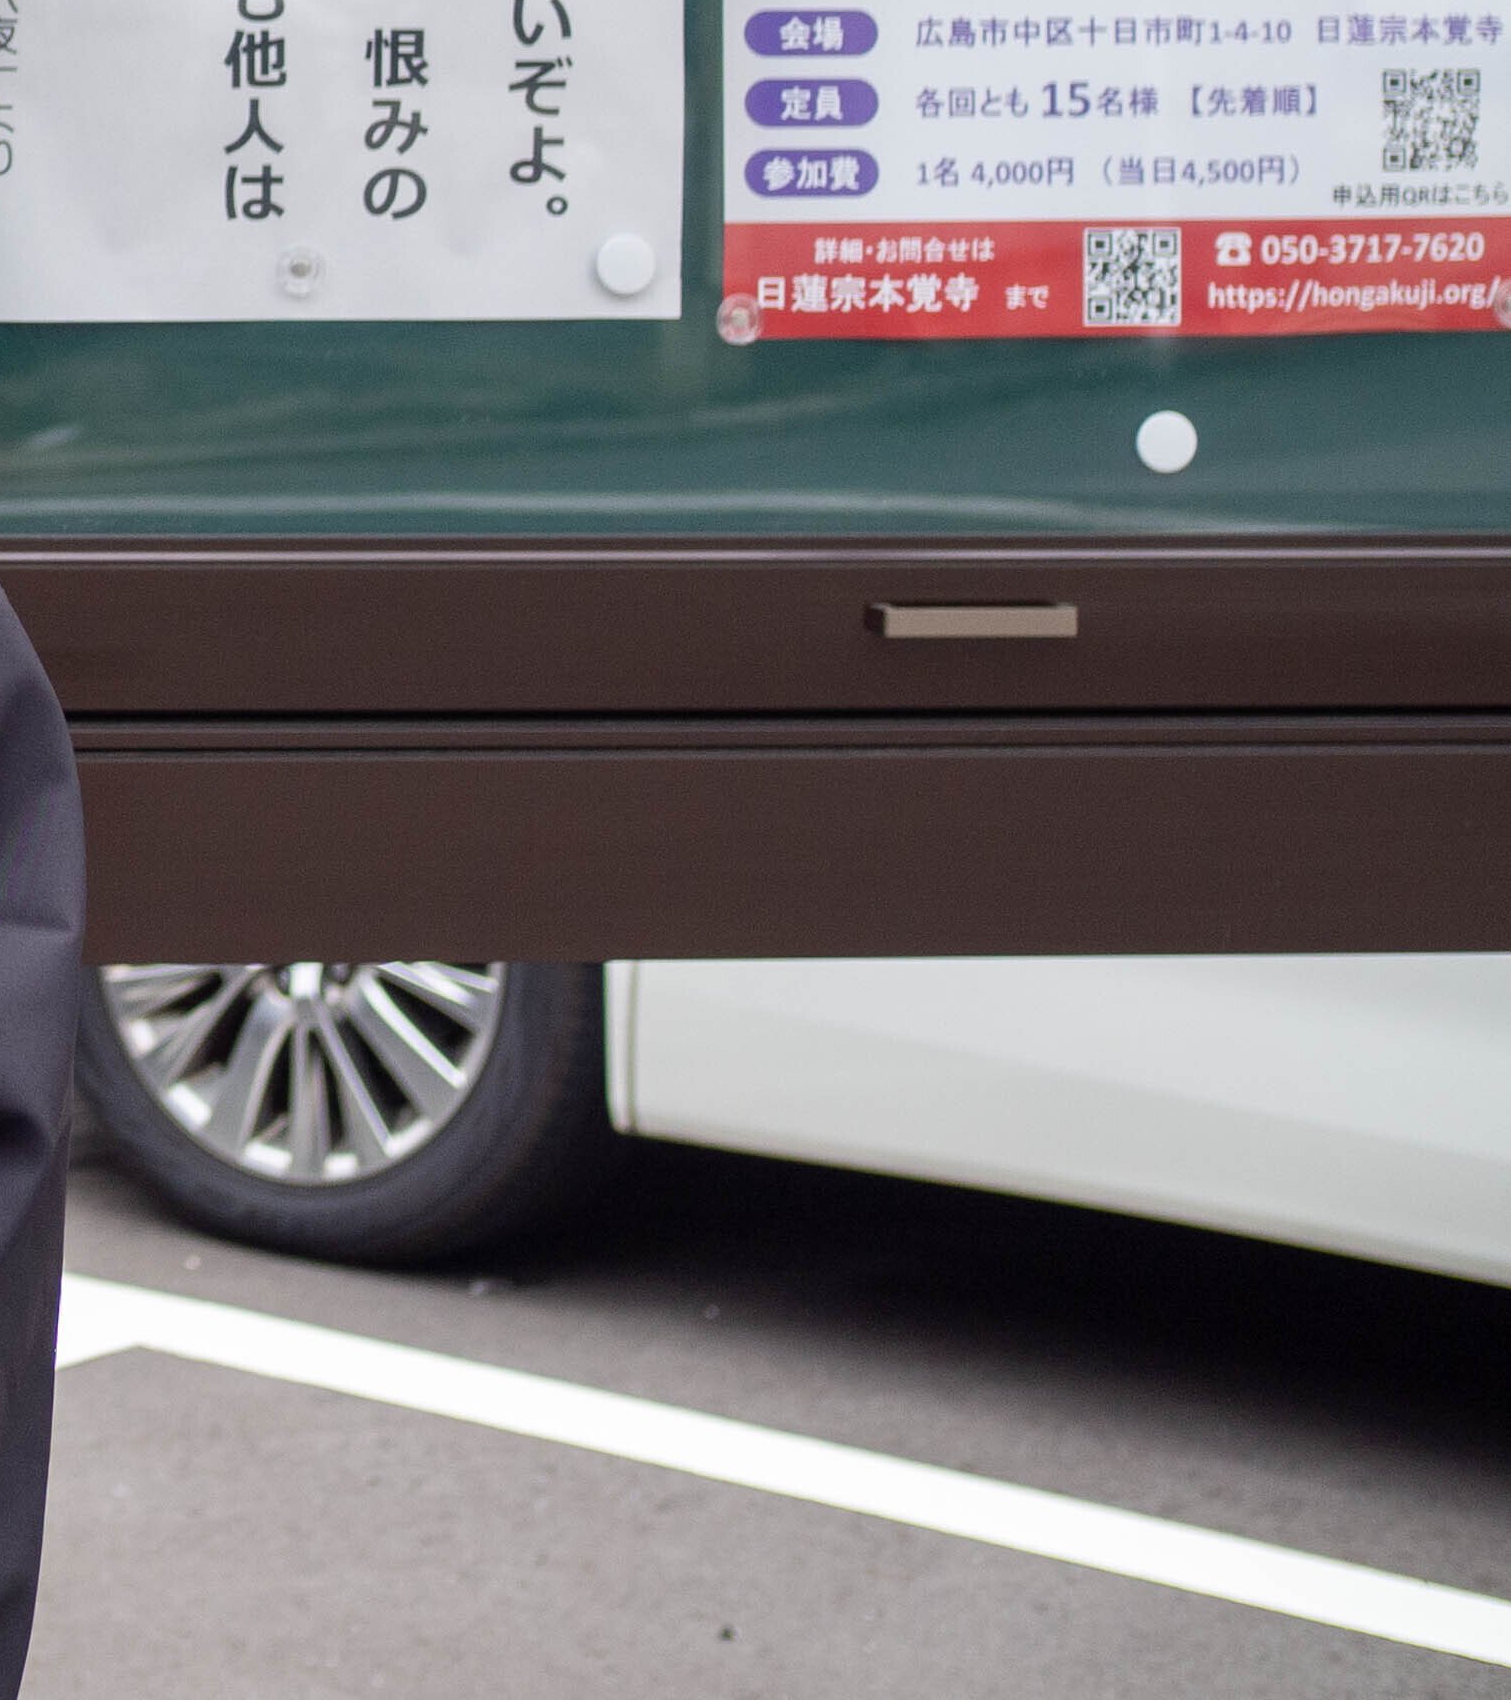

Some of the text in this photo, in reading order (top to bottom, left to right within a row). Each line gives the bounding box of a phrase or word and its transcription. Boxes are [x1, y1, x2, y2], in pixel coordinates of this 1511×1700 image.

[779, 15, 845, 52] 会場
[915, 14, 1504, 48] 広島市中区十日市町1-4-10 日蓮宗本覚寺
[780, 85, 844, 122] 定員
[762, 155, 861, 192] 参加費
[1332, 183, 1511, 208] 申込用QRはこちら
[813, 236, 996, 266] 詳細・お問合せは
[1259, 231, 1486, 266] 050-3717-7620
[756, 273, 1050, 314] 日蓮宗本覚寺 まで
[1207, 274, 1502, 314] https://hongakuji.org/
